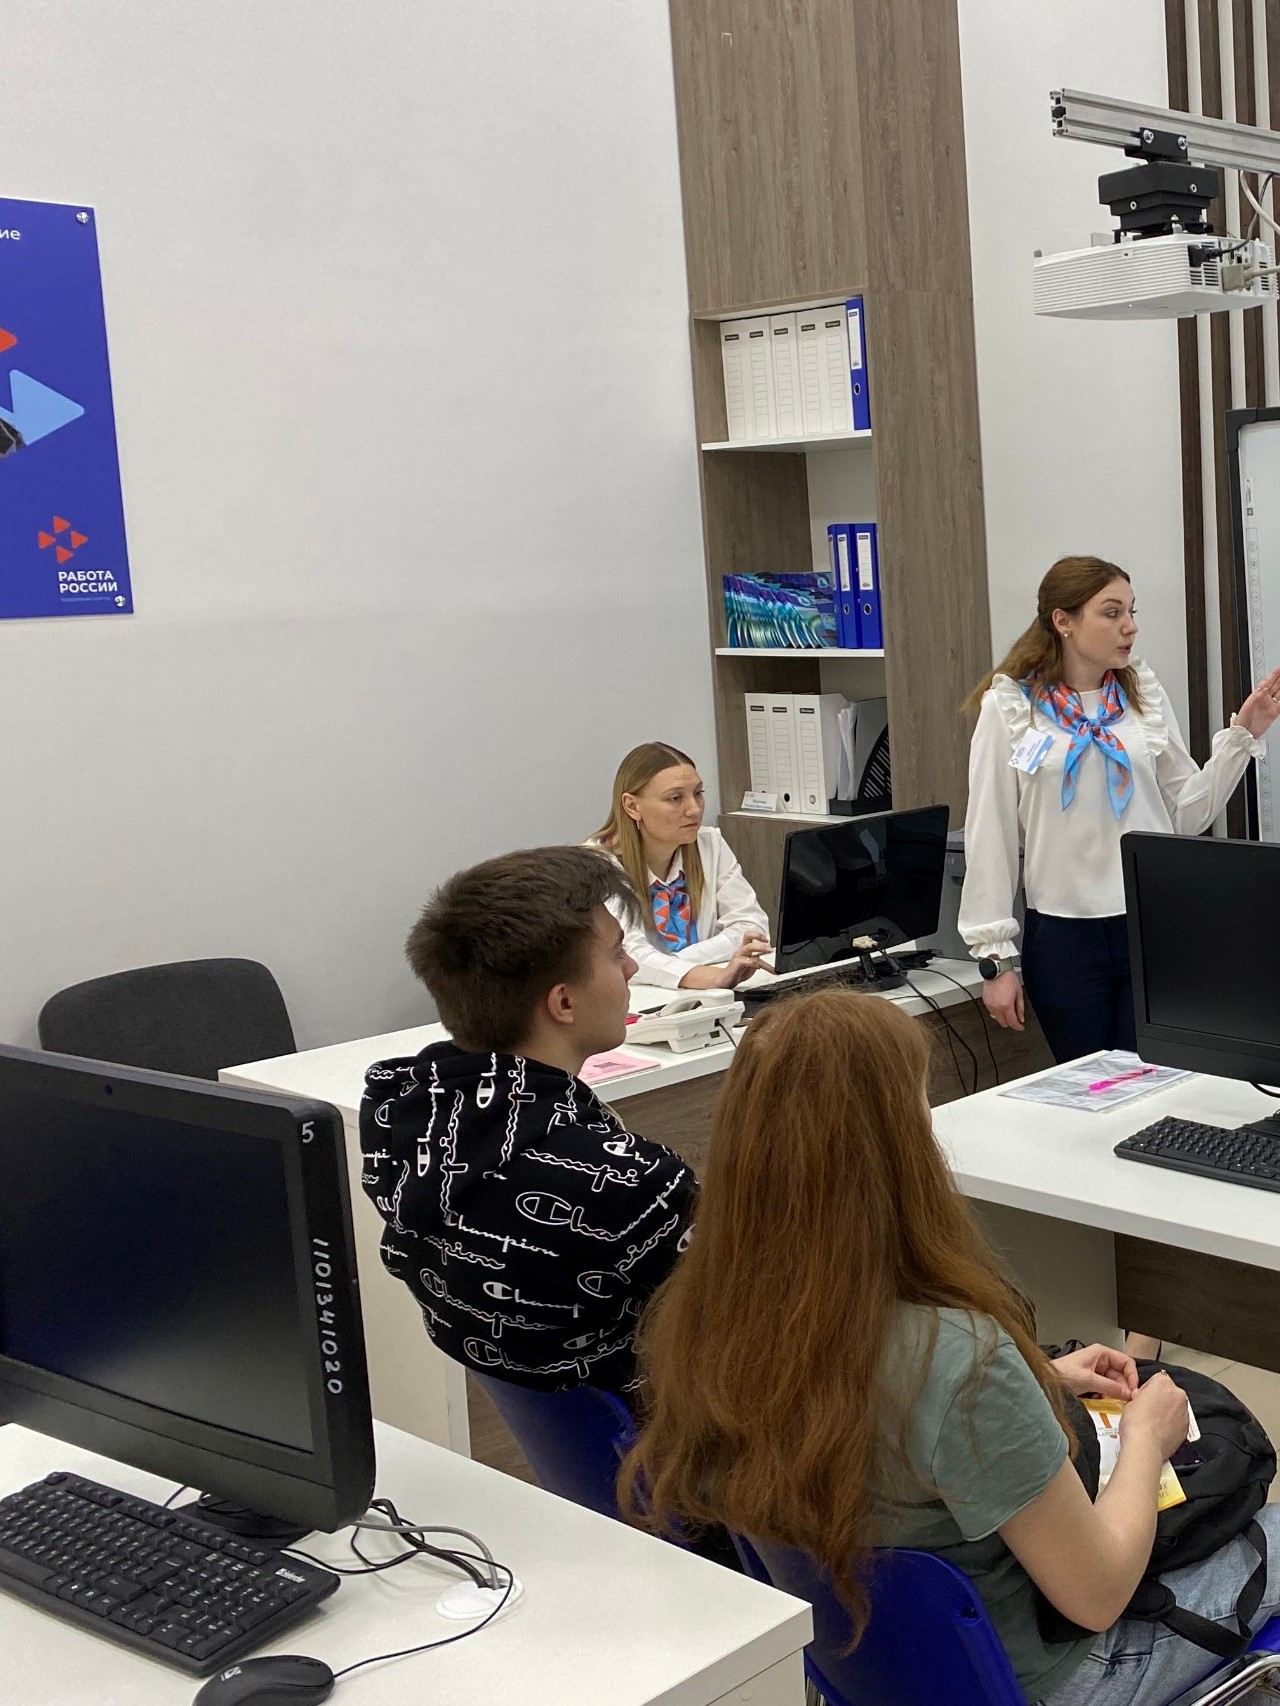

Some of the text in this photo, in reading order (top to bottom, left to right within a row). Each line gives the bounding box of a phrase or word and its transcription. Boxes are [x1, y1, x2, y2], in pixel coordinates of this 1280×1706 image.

[58, 570, 115, 582] РАБОТА
[59, 581, 118, 594] РОССИИ
[301, 1120, 316, 1144] 5
[312, 1237, 344, 1395] 1101341020
